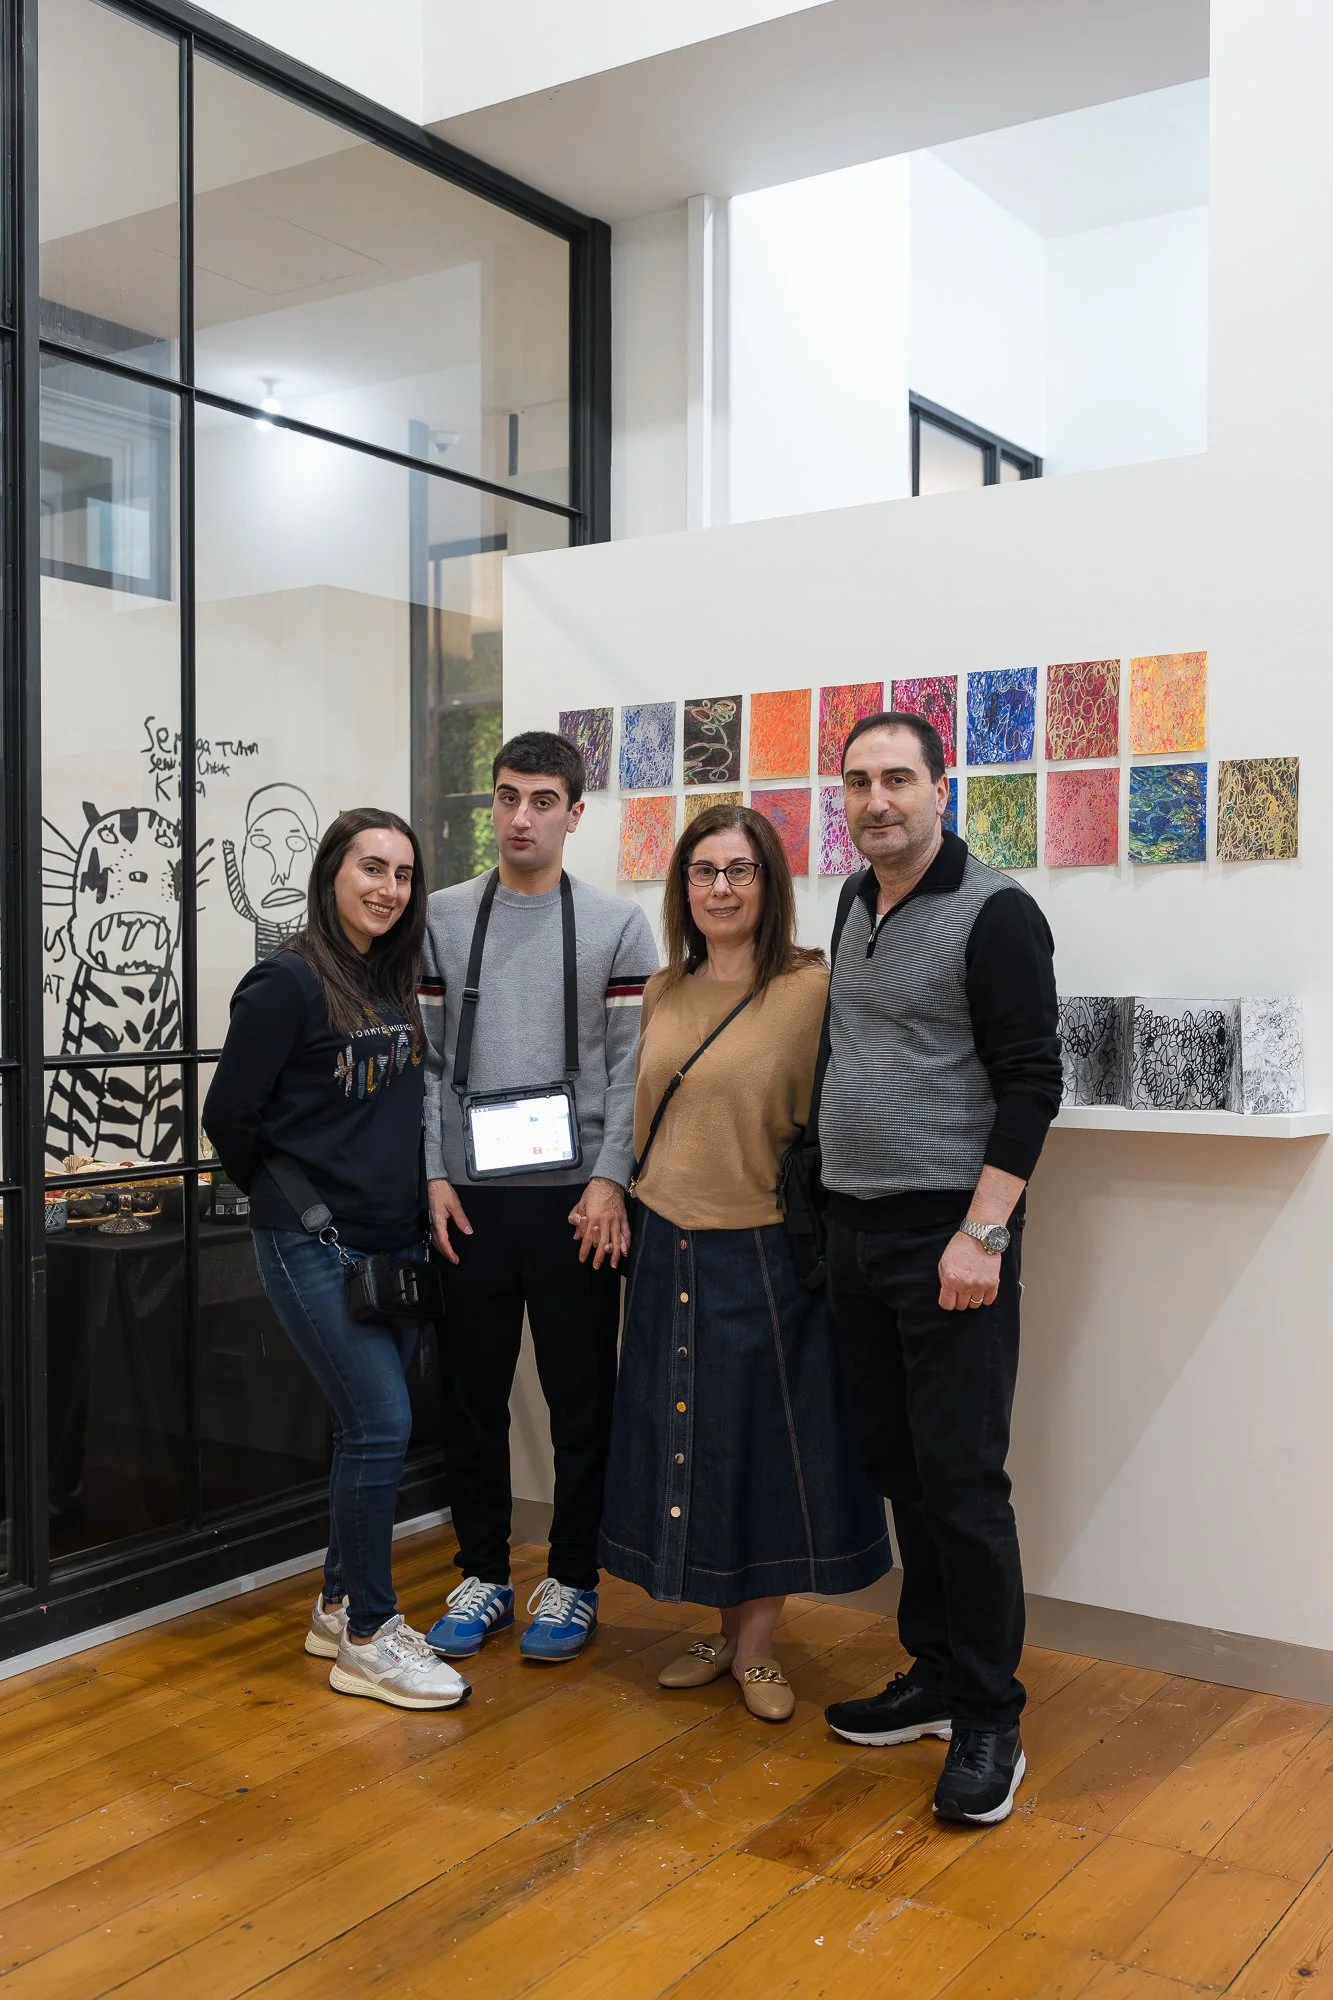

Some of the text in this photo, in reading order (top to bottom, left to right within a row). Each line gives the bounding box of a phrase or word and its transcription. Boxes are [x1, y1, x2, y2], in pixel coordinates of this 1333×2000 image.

[155, 772, 206, 802] Kia
[349, 1023, 415, 1039] TOMMY HILFIGE
